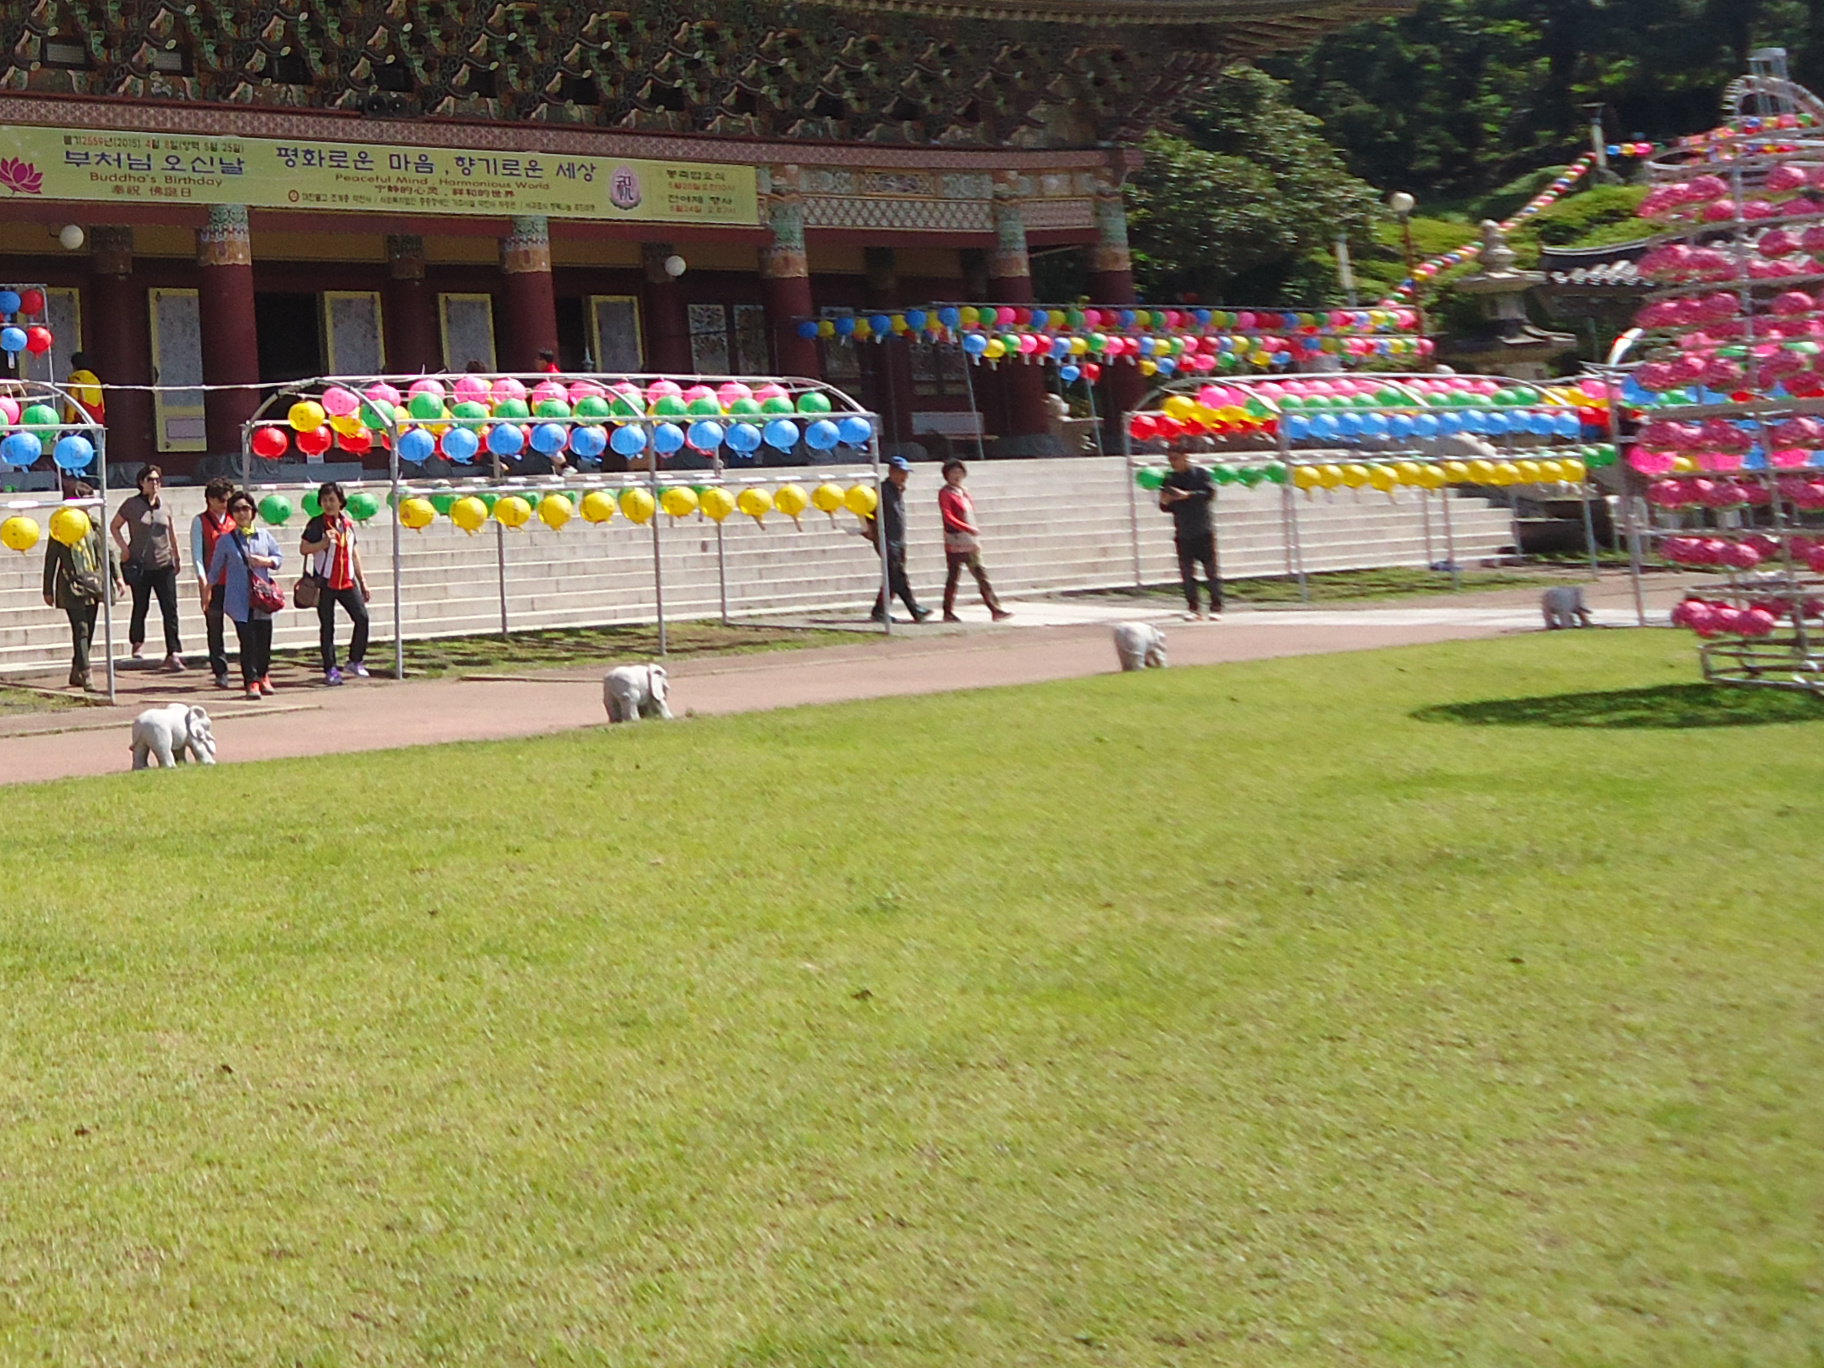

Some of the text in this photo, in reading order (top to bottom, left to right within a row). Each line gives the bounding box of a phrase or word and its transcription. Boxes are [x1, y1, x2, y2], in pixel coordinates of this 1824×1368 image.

[64, 150, 245, 176] 부처님 오신날
[276, 147, 375, 171] 평화로운
[454, 156, 544, 179] 향기로운
[556, 162, 597, 182] 세상
[90, 172, 223, 188] Buddha's Birthday
[335, 173, 391, 184] Peaceful
[440, 179, 512, 190] Harmonious
[516, 181, 550, 191] World
[666, 169, 726, 182] 봉축법요식
[616, 175, 634, 201] 祝
